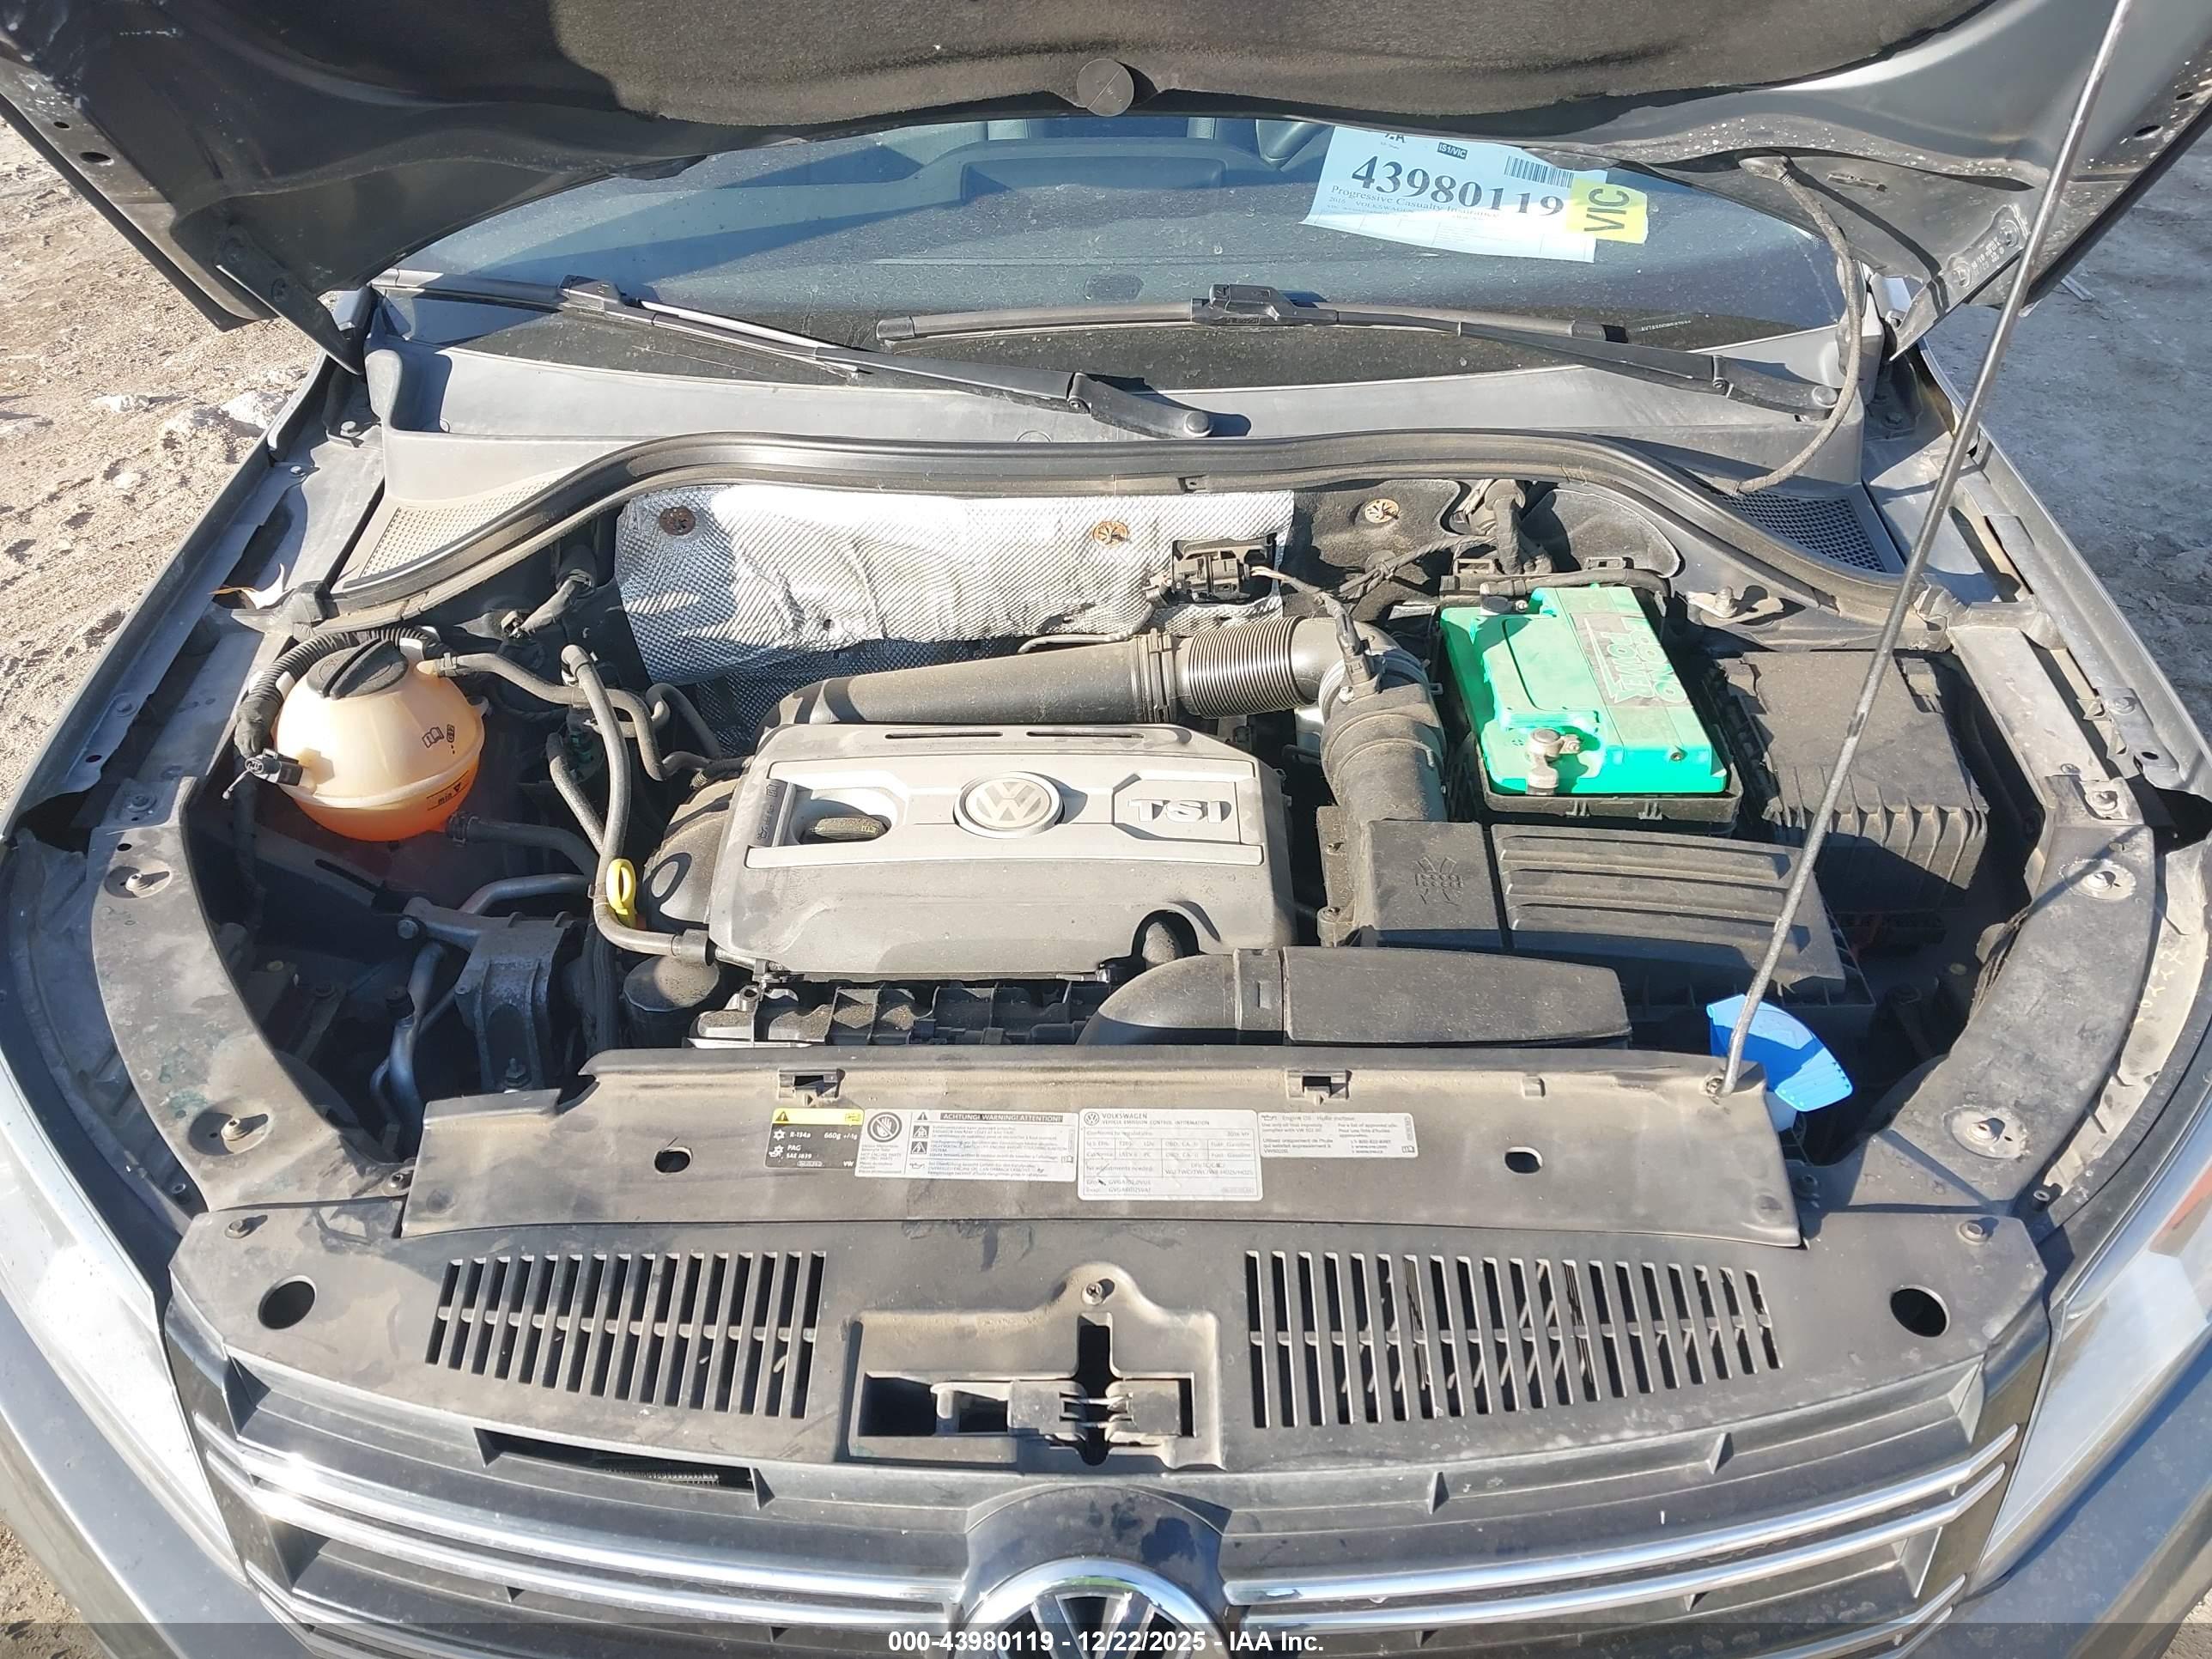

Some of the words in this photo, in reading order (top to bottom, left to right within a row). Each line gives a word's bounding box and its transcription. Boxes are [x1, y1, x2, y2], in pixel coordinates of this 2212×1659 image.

[1351, 155, 1564, 216] 43980119
[1330, 185, 1394, 204] Progressive
[1395, 198, 1443, 212] Casualty
[1583, 188, 1629, 232] VIC
[438, 790, 453, 805] min
[1128, 799, 1224, 823] TSI
[823, 1132, 842, 1140] 660g
